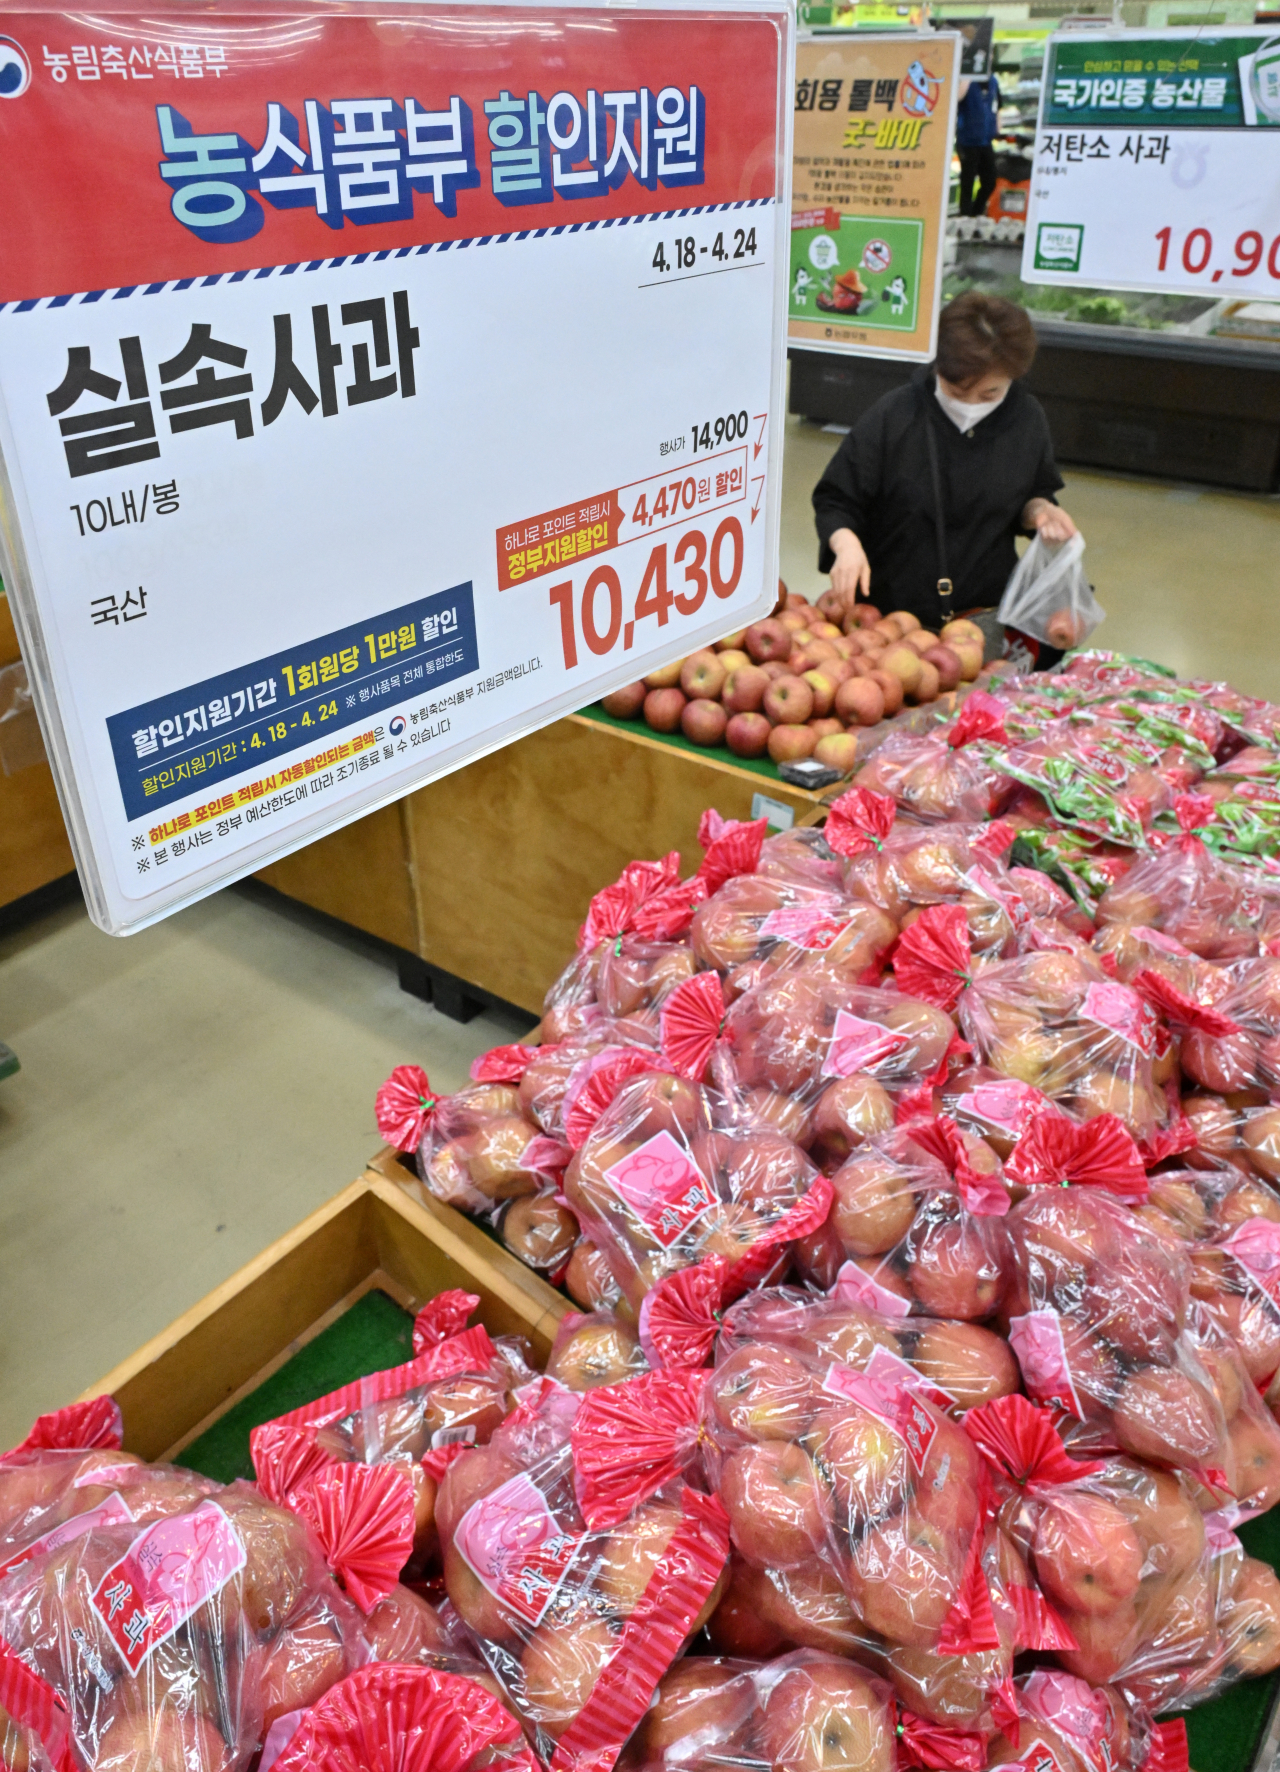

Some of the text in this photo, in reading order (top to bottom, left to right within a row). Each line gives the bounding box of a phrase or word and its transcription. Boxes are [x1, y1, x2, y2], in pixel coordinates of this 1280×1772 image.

[42, 44, 229, 83] 농림축산식품부
[848, 79, 899, 112] 롤백
[1054, 78, 1227, 108] 국가인증 농산물
[156, 86, 698, 228] 농식품부 할인지원
[843, 118, 926, 149] 굿-바이
[1040, 133, 1171, 165] 저탄소 사과
[46, 290, 420, 478] 실속사과
[659, 410, 748, 456] 행사가 14,900
[69, 479, 181, 536] 10내/봉
[716, 466, 742, 498] 할인
[504, 500, 610, 551] 하나로 포인트 적립시
[508, 521, 608, 580] 정부지원할인
[90, 586, 148, 625] 국산
[549, 515, 744, 671] 10,430
[131, 607, 458, 758] 할인지원기간 1회원당 1만원 할인
[359, 674, 400, 702] 행사품목
[402, 665, 424, 684] 전체
[425, 649, 465, 675] 통합한도
[141, 742, 238, 796] 할인지원기간
[149, 808, 193, 843] 하나로
[194, 793, 236, 821] 포인트
[238, 775, 277, 802] 적립시
[279, 744, 350, 785] 자동할인되는
[352, 726, 385, 752] 금액은
[410, 687, 475, 725] 농림축산식품부
[476, 656, 543, 695] 지원금액입니다.
[154, 849, 169, 866] 본
[171, 830, 213, 857] 행사는
[216, 815, 243, 837] 정부
[246, 784, 308, 823] 예산한도에
[311, 771, 334, 794] 따라
[337, 749, 380, 783] 조기종료
[383, 744, 394, 760] 될
[396, 739, 408, 753] 수
[410, 717, 451, 748] 있습니다
[659, 1185, 709, 1235] 사과
[138, 1541, 163, 1574] 실속
[518, 1534, 576, 1605] 사과
[104, 1580, 150, 1655] 사과
